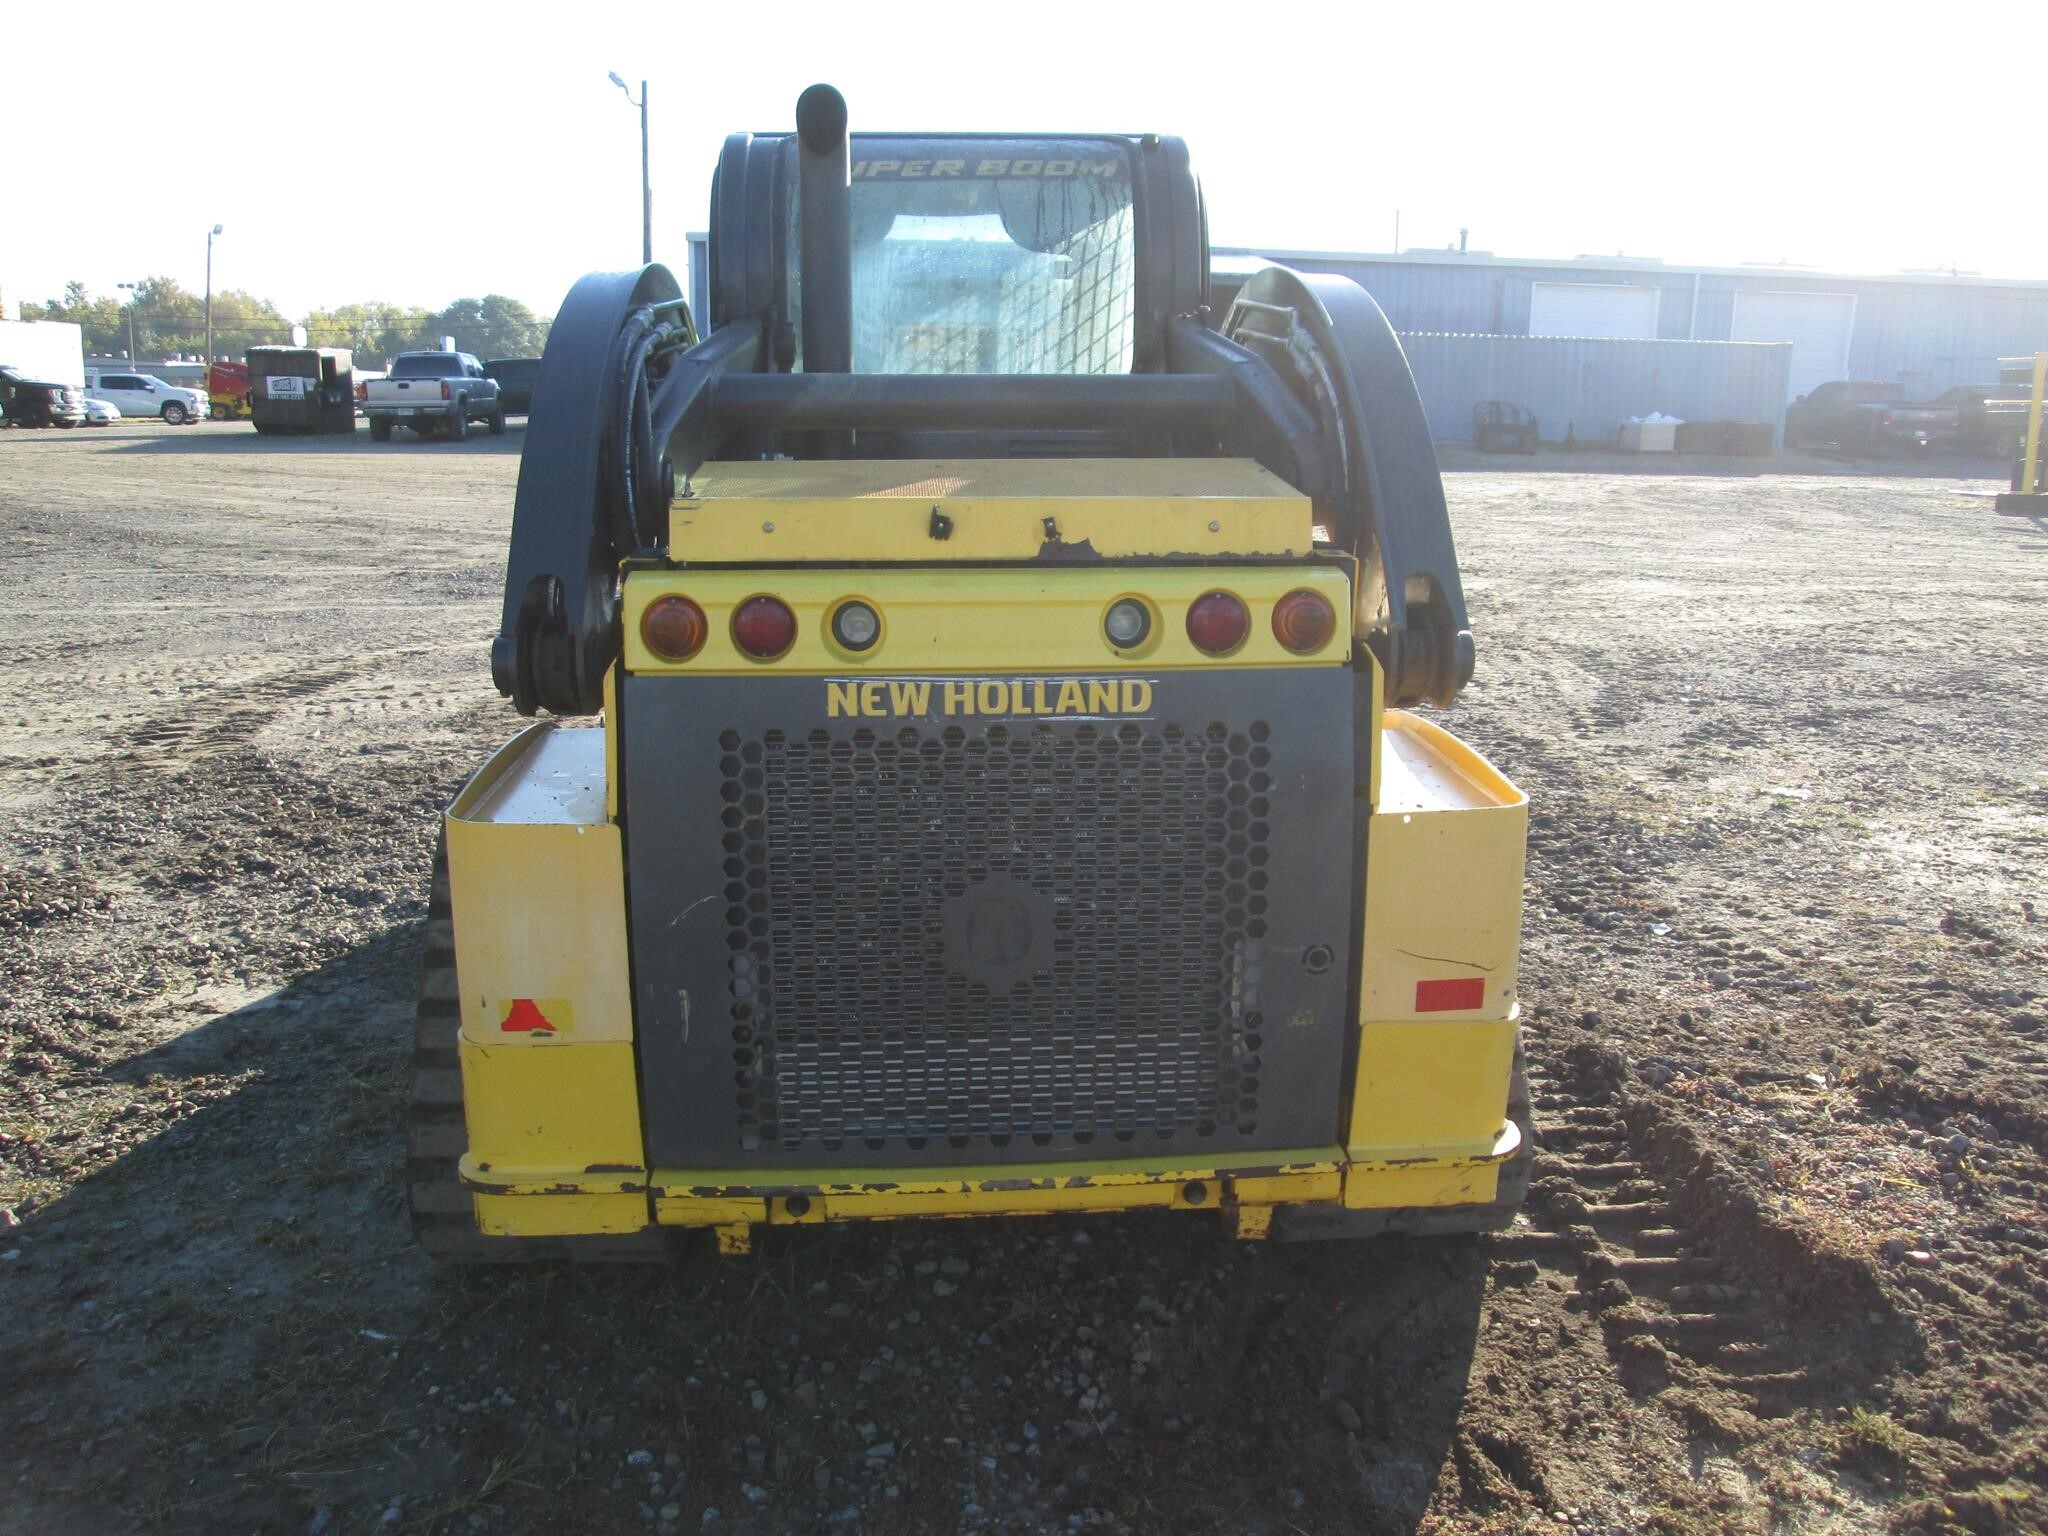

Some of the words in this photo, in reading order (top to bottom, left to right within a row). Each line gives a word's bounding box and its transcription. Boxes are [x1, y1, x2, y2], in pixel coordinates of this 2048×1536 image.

[975, 159, 1117, 177] BOOM
[827, 682, 931, 717] NEW
[944, 680, 1152, 715] HOLLAND
